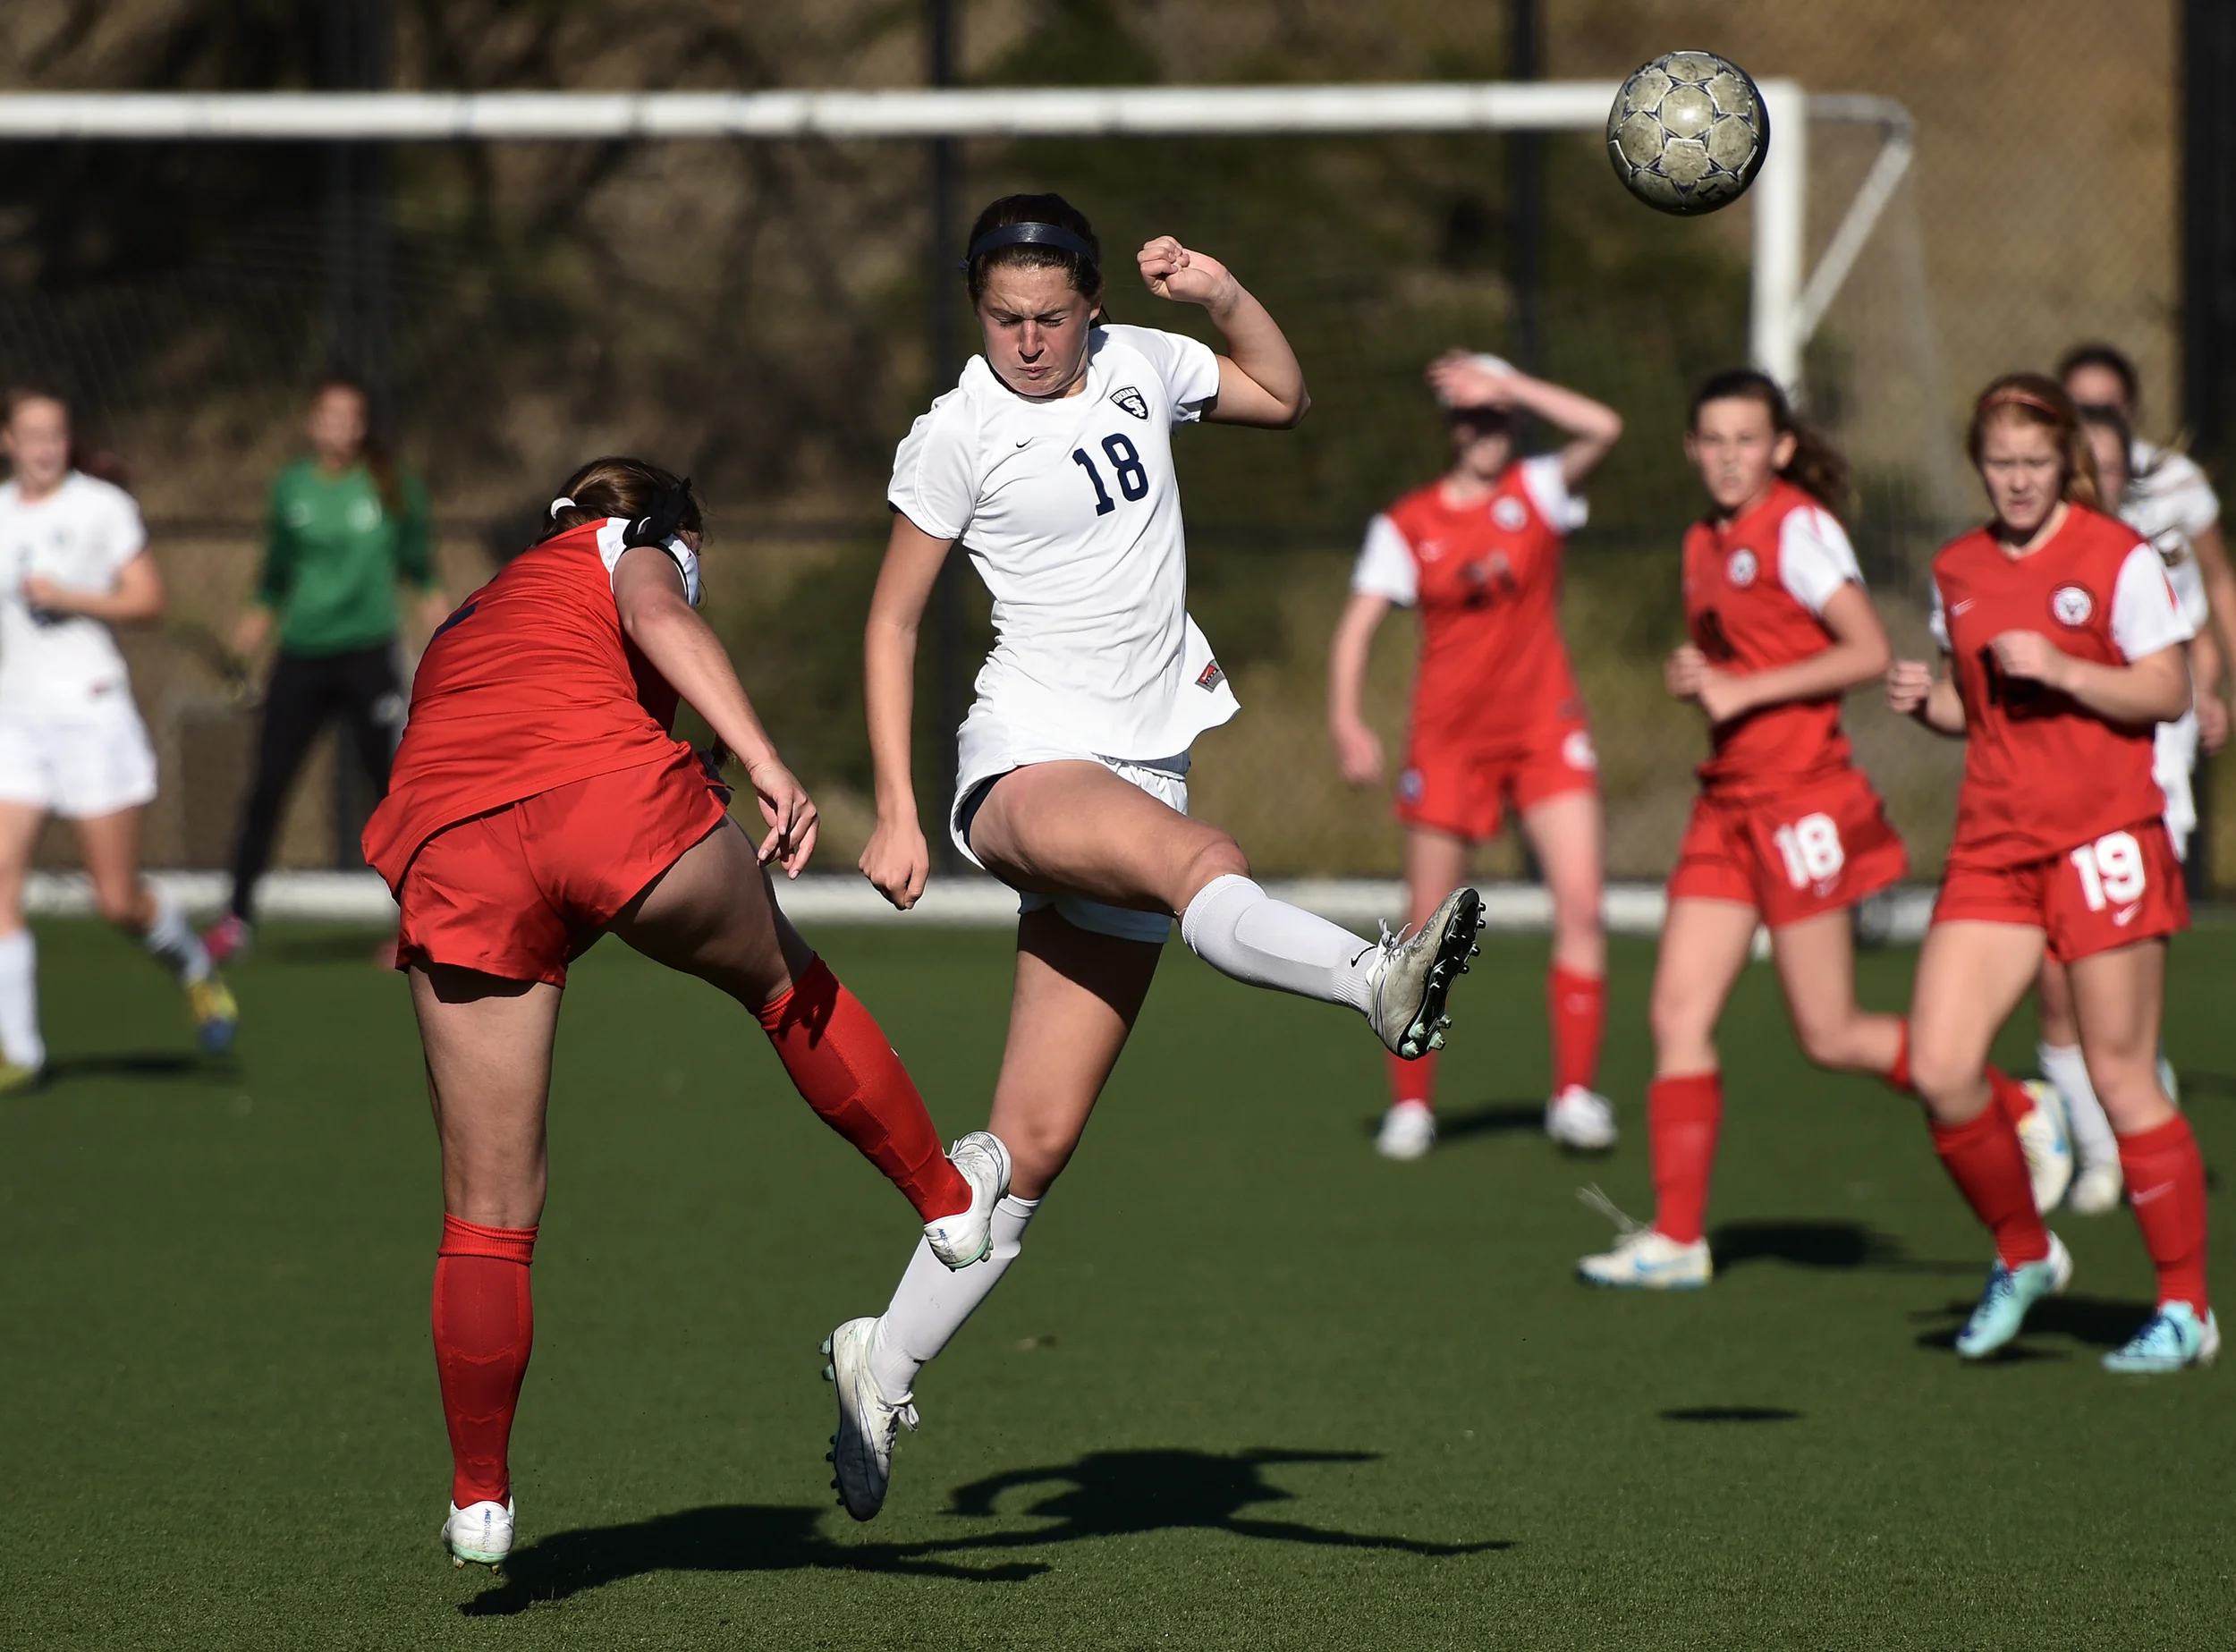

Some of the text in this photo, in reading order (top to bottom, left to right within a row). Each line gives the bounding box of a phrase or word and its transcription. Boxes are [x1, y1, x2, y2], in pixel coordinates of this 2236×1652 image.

[1071, 433, 1149, 517] 18
[1774, 812, 1844, 889] 18
[2071, 831, 2146, 911] 19
